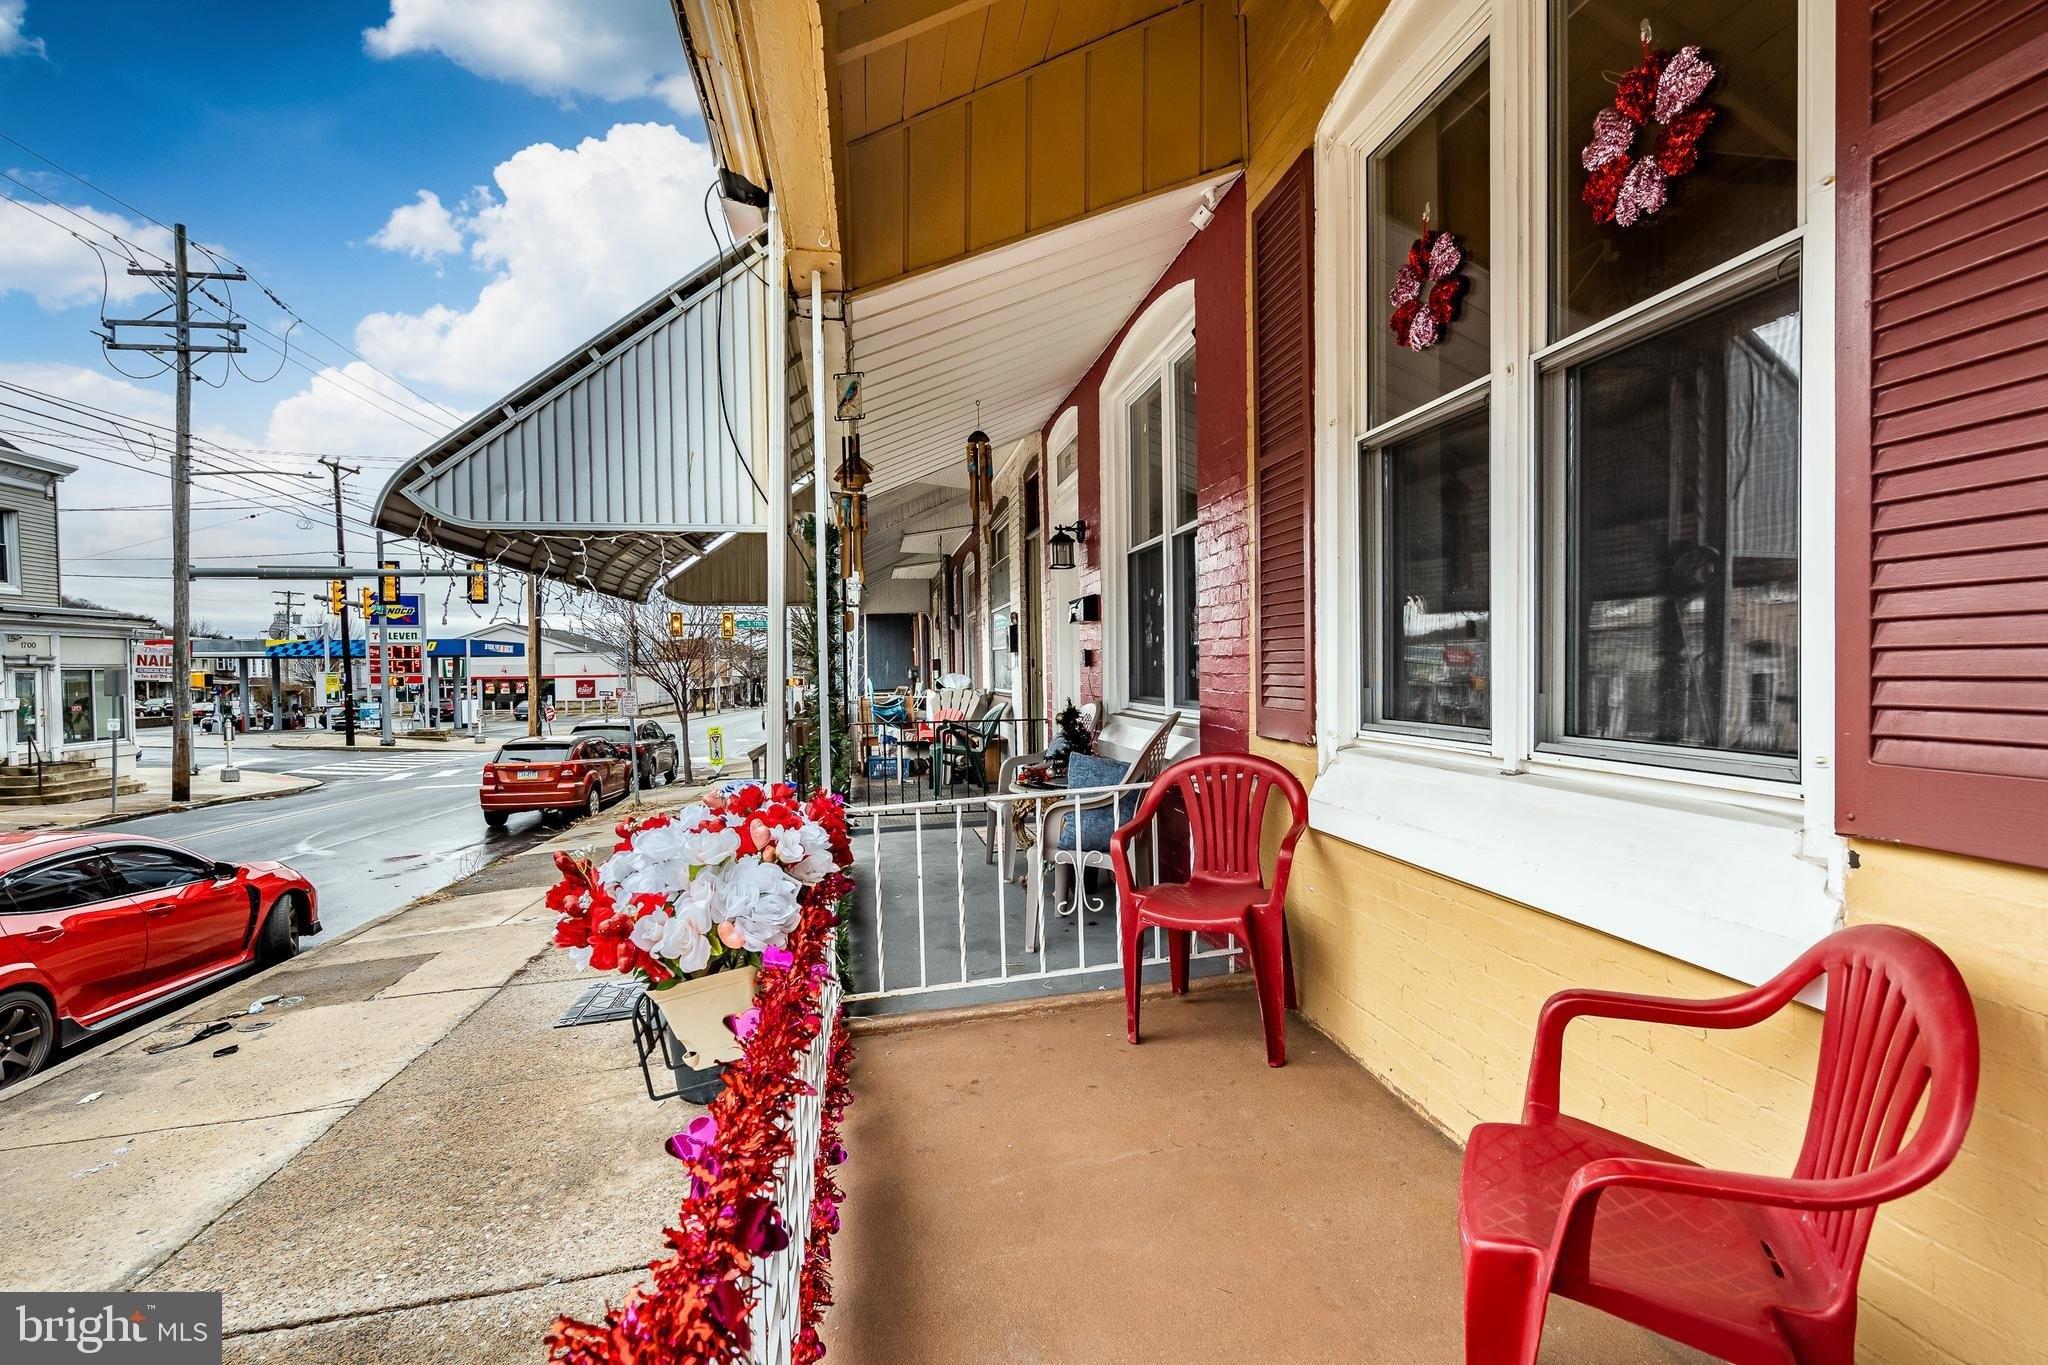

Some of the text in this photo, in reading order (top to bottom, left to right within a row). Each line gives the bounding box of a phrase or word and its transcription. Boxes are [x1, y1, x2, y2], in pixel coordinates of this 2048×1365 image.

[387, 607, 414, 615] NOCO
[20, 641, 37, 649] 1700
[137, 654, 173, 666] NAIL
